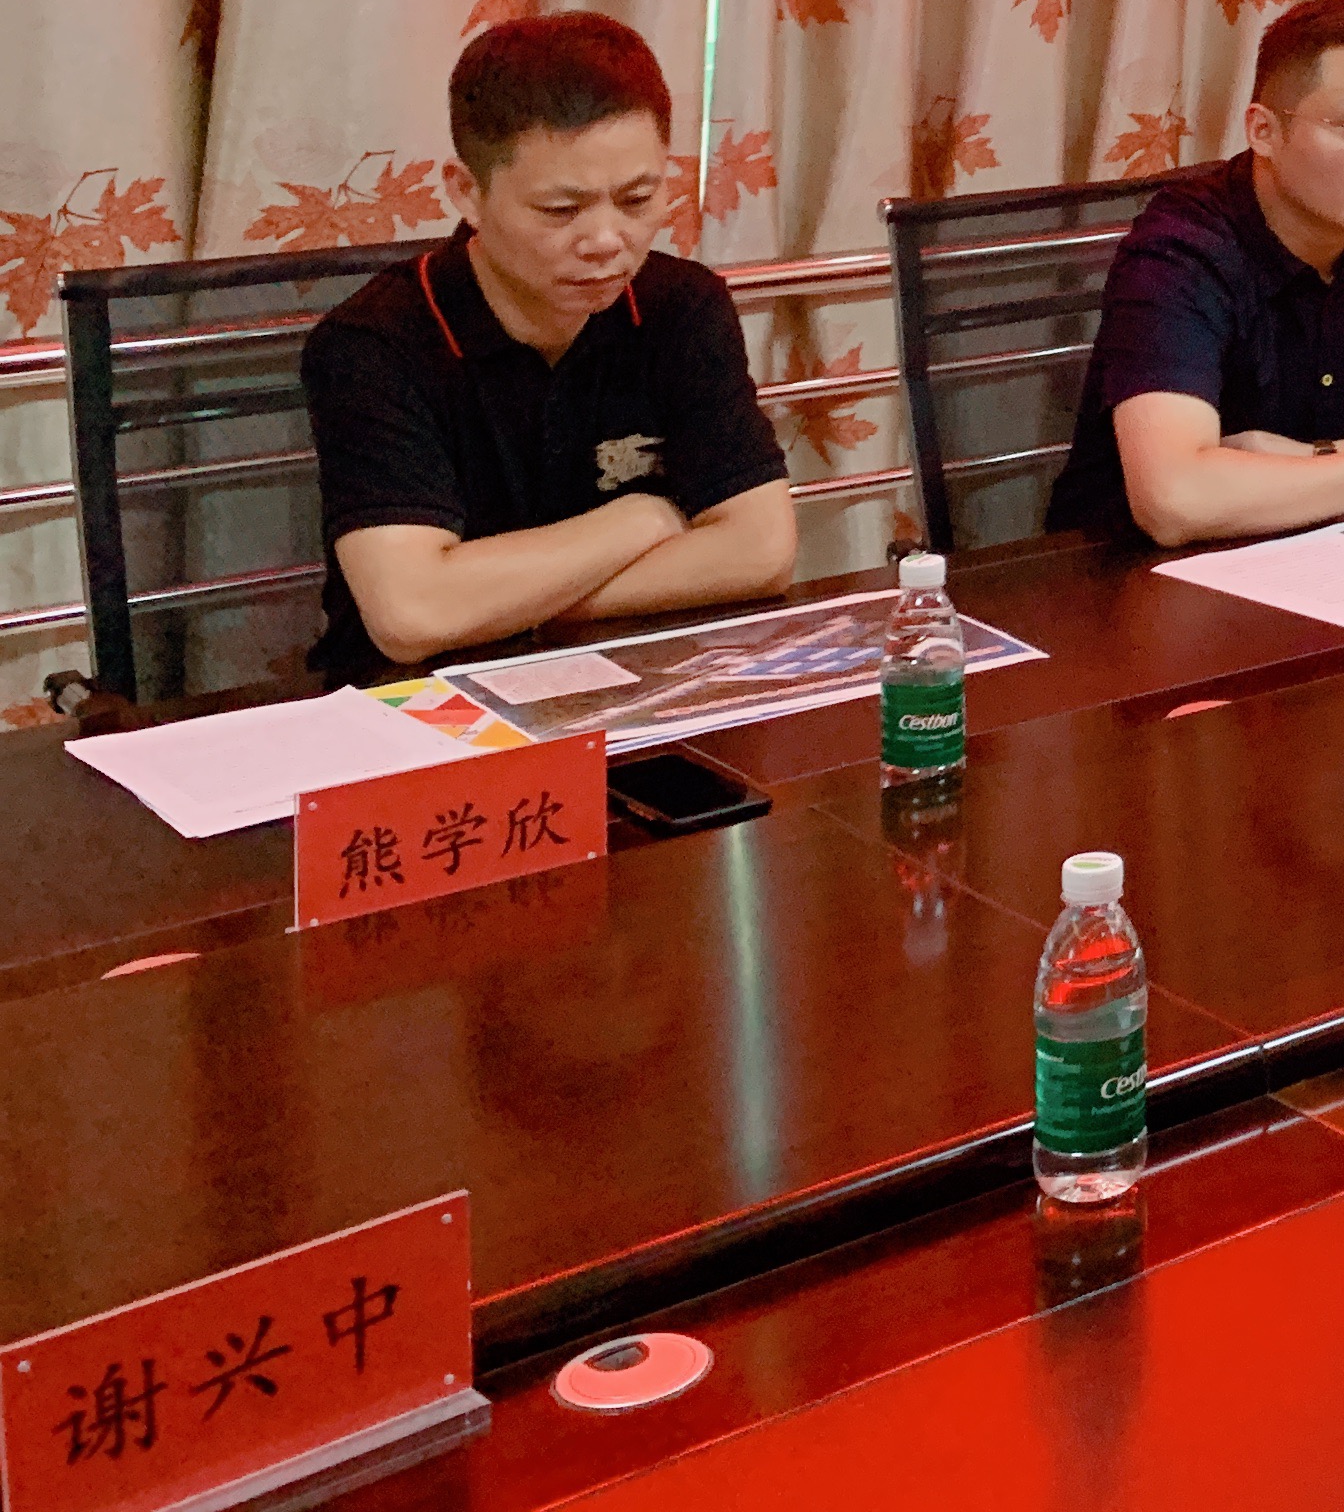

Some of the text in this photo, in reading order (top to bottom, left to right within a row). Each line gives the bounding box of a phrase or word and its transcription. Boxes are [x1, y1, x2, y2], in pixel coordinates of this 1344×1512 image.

[339, 791, 571, 899] 熊学欣
[52, 1277, 399, 1465] 谢兴中
